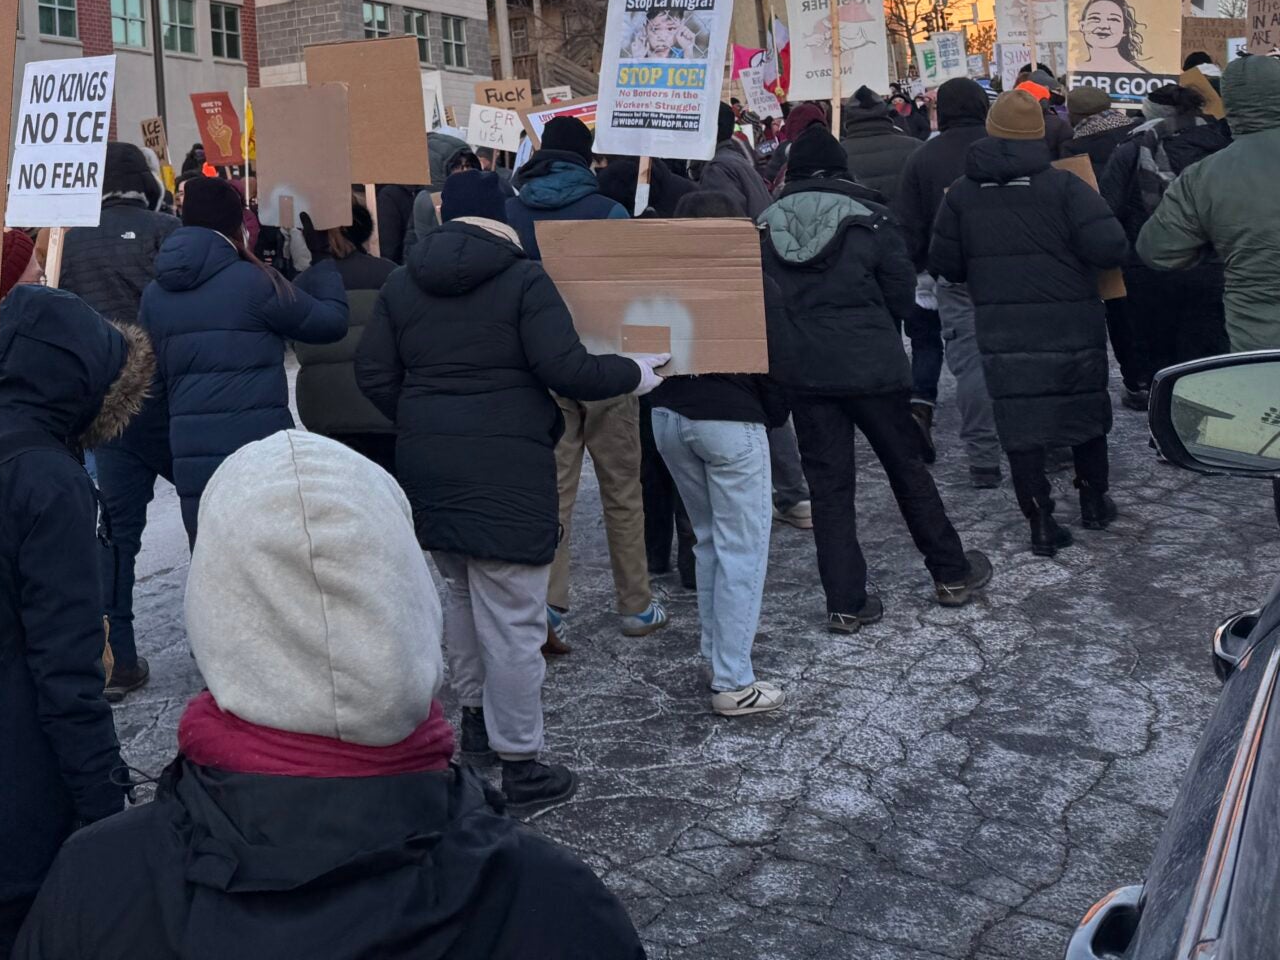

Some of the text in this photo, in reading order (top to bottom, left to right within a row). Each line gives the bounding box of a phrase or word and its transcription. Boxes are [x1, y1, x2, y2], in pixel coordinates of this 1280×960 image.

[1252, 15, 1266, 30] IN
[1250, 30, 1272, 48] ARE
[619, 67, 704, 87] STOP ICE!
[1069, 75, 1111, 93] FOR
[30, 71, 108, 104] NO KINGS
[484, 87, 526, 104] Fuck
[619, 89, 698, 99] No Borders in the
[615, 101, 700, 112] Workers' Struggle!
[479, 110, 515, 127] CPR
[21, 111, 107, 144] NO ICE
[142, 120, 161, 136] ICE
[480, 128, 504, 144] USA
[18, 161, 98, 189] NO FEAR
